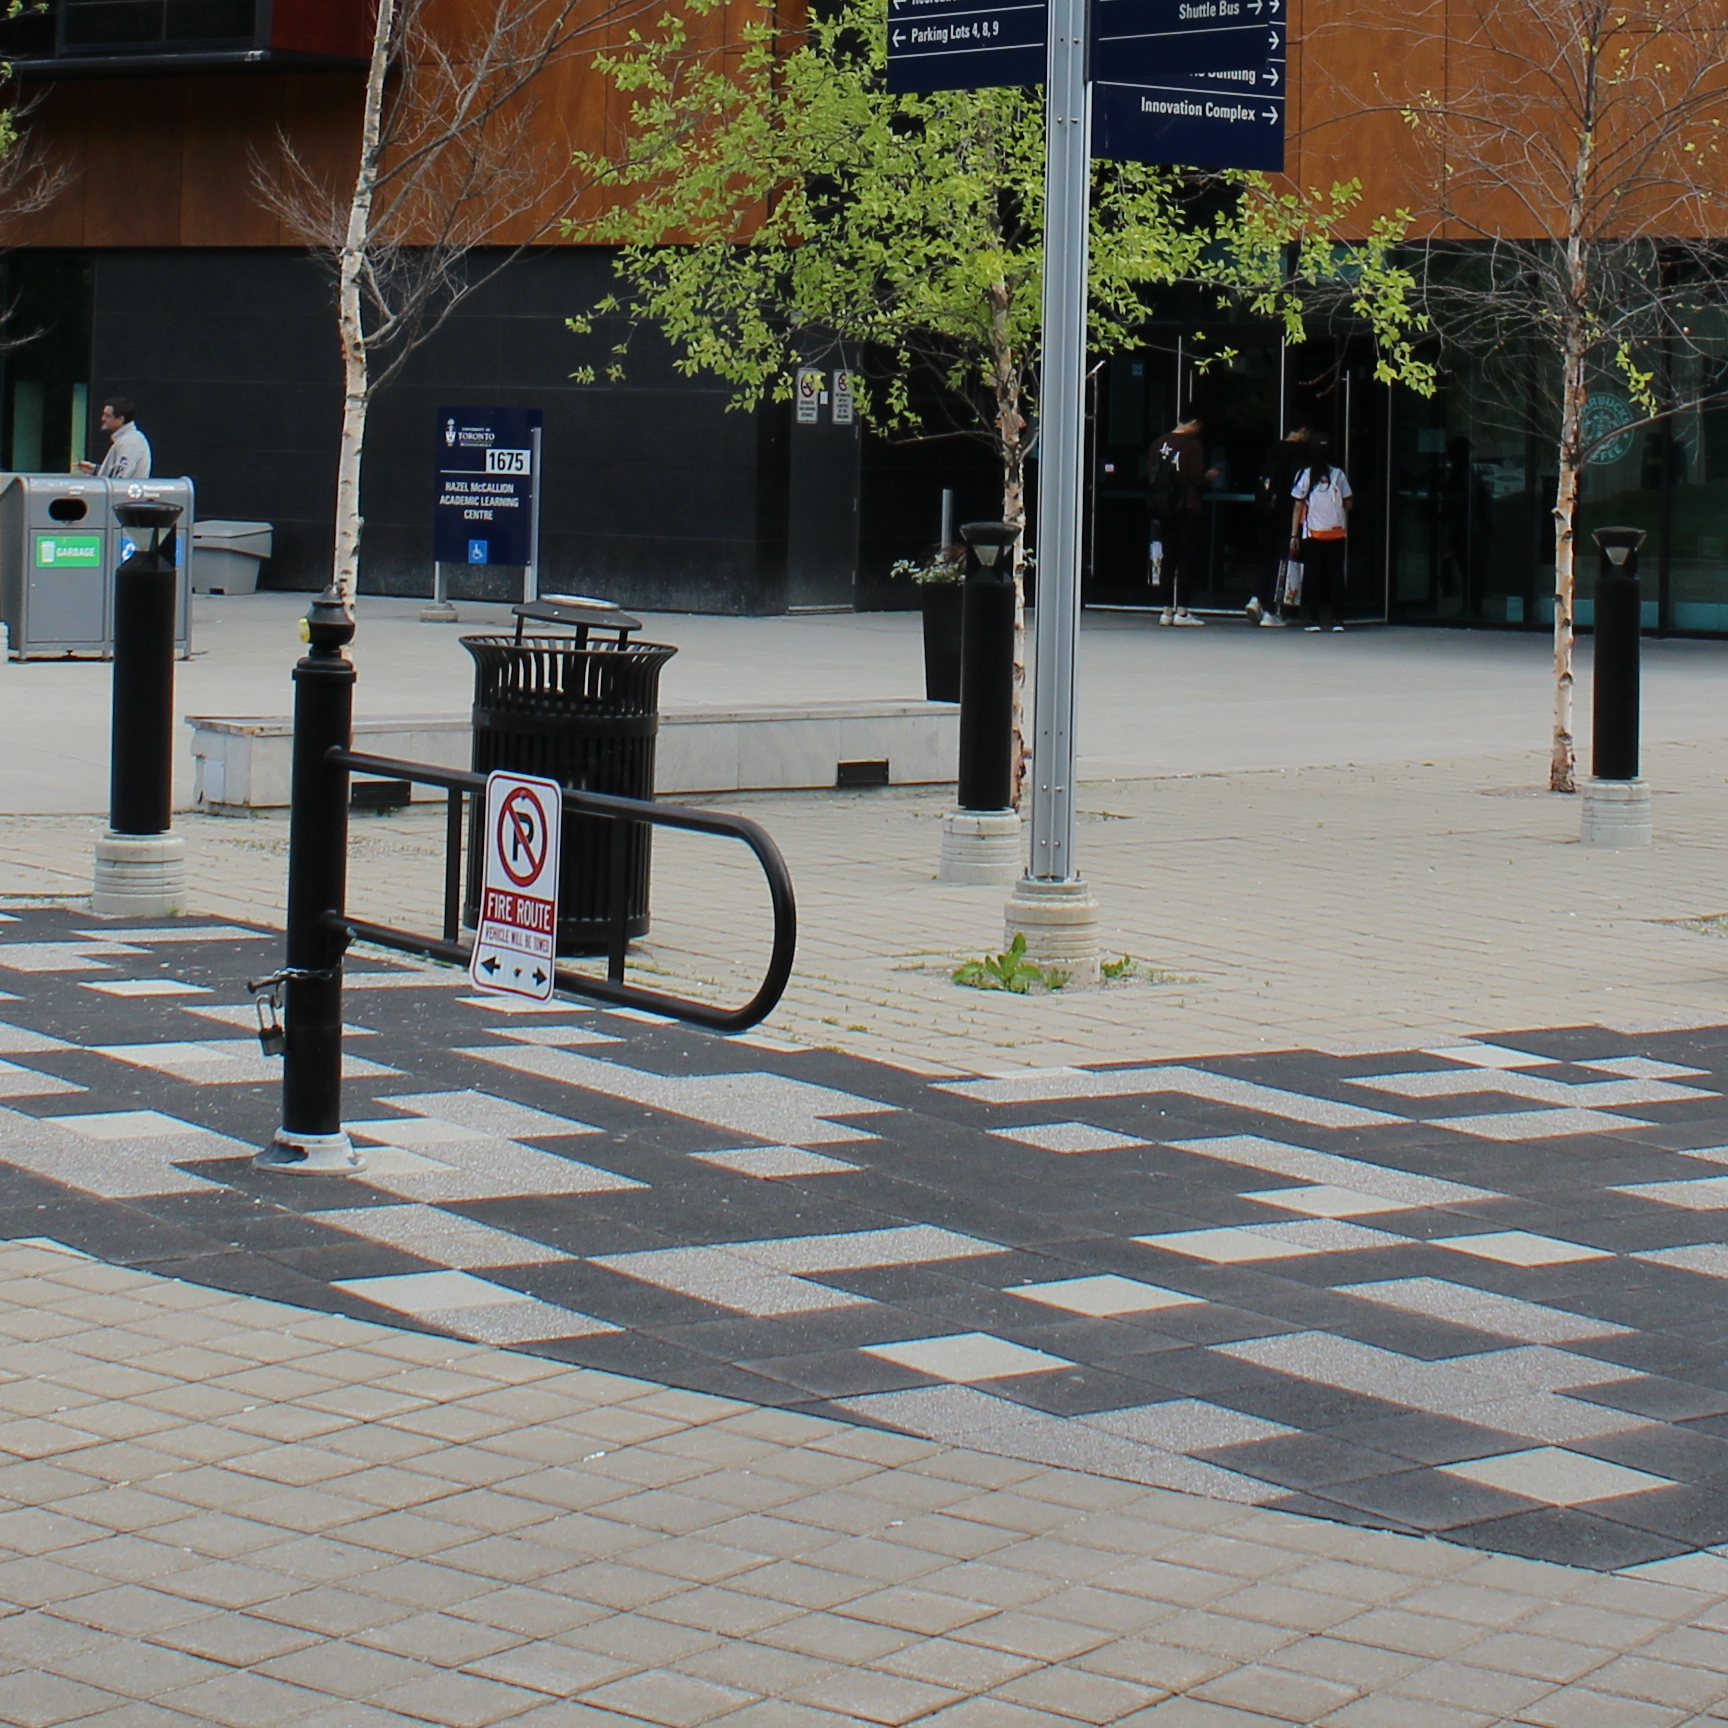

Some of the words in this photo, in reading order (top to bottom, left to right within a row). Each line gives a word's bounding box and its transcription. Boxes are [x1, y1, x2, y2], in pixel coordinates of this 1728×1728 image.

[1178, 1, 1217, 20] Shuttle
[1219, 0, 1240, 16] Bus
[911, 26, 948, 44] Parking
[950, 24, 971, 40] Lots
[972, 22, 981, 39] 4,
[982, 21, 991, 38] 8,
[992, 20, 1000, 36] 9
[1141, 96, 1203, 117] Innovation
[1205, 101, 1256, 123] Complex
[457, 432, 495, 441] TORONTO
[488, 451, 524, 472] 1675
[445, 481, 469, 492] HAZEL
[470, 482, 515, 494] McCALLION
[439, 494, 480, 507] ACADEMIC
[480, 495, 519, 508] LEARNING
[463, 509, 494, 521] CENTRE
[56, 546, 96, 558] GARBAGE
[486, 891, 513, 922] FIRE
[516, 898, 552, 931] ROUTE
[485, 925, 509, 944] VEHICLE
[511, 931, 524, 948] WILL
[533, 936, 550, 953] TOWED
